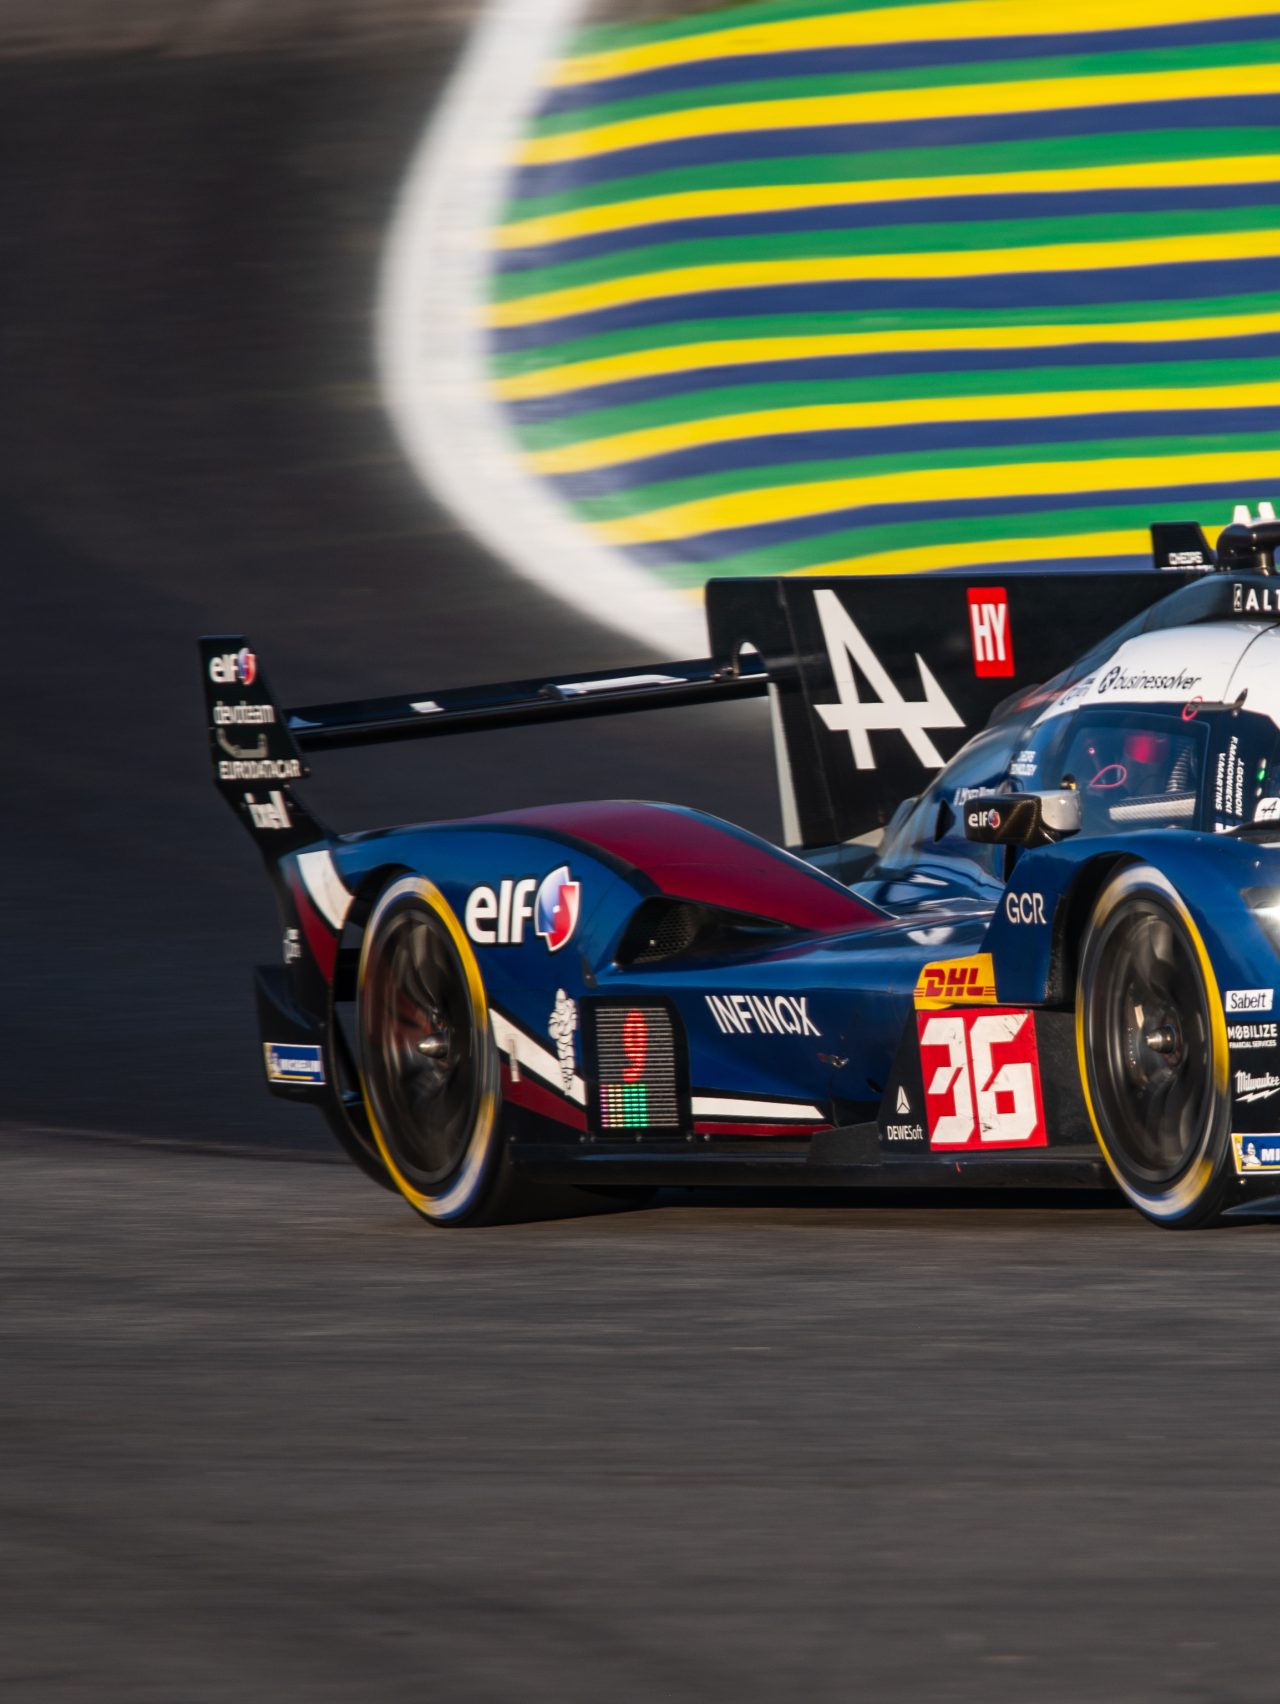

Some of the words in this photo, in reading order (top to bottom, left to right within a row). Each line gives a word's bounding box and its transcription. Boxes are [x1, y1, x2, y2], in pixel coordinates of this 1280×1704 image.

[971, 603, 1007, 661] HY
[209, 654, 237, 682] elf
[1113, 668, 1201, 690] businessolver
[967, 810, 988, 828] elf
[465, 878, 537, 944] elf
[1006, 891, 1047, 925] GCR
[924, 968, 985, 997] DHL
[1231, 991, 1267, 1010] Sabelt
[921, 1013, 1037, 1143] 36
[1234, 1069, 1280, 1094] Milwaukee
[886, 1123, 924, 1140] DEWESoft
